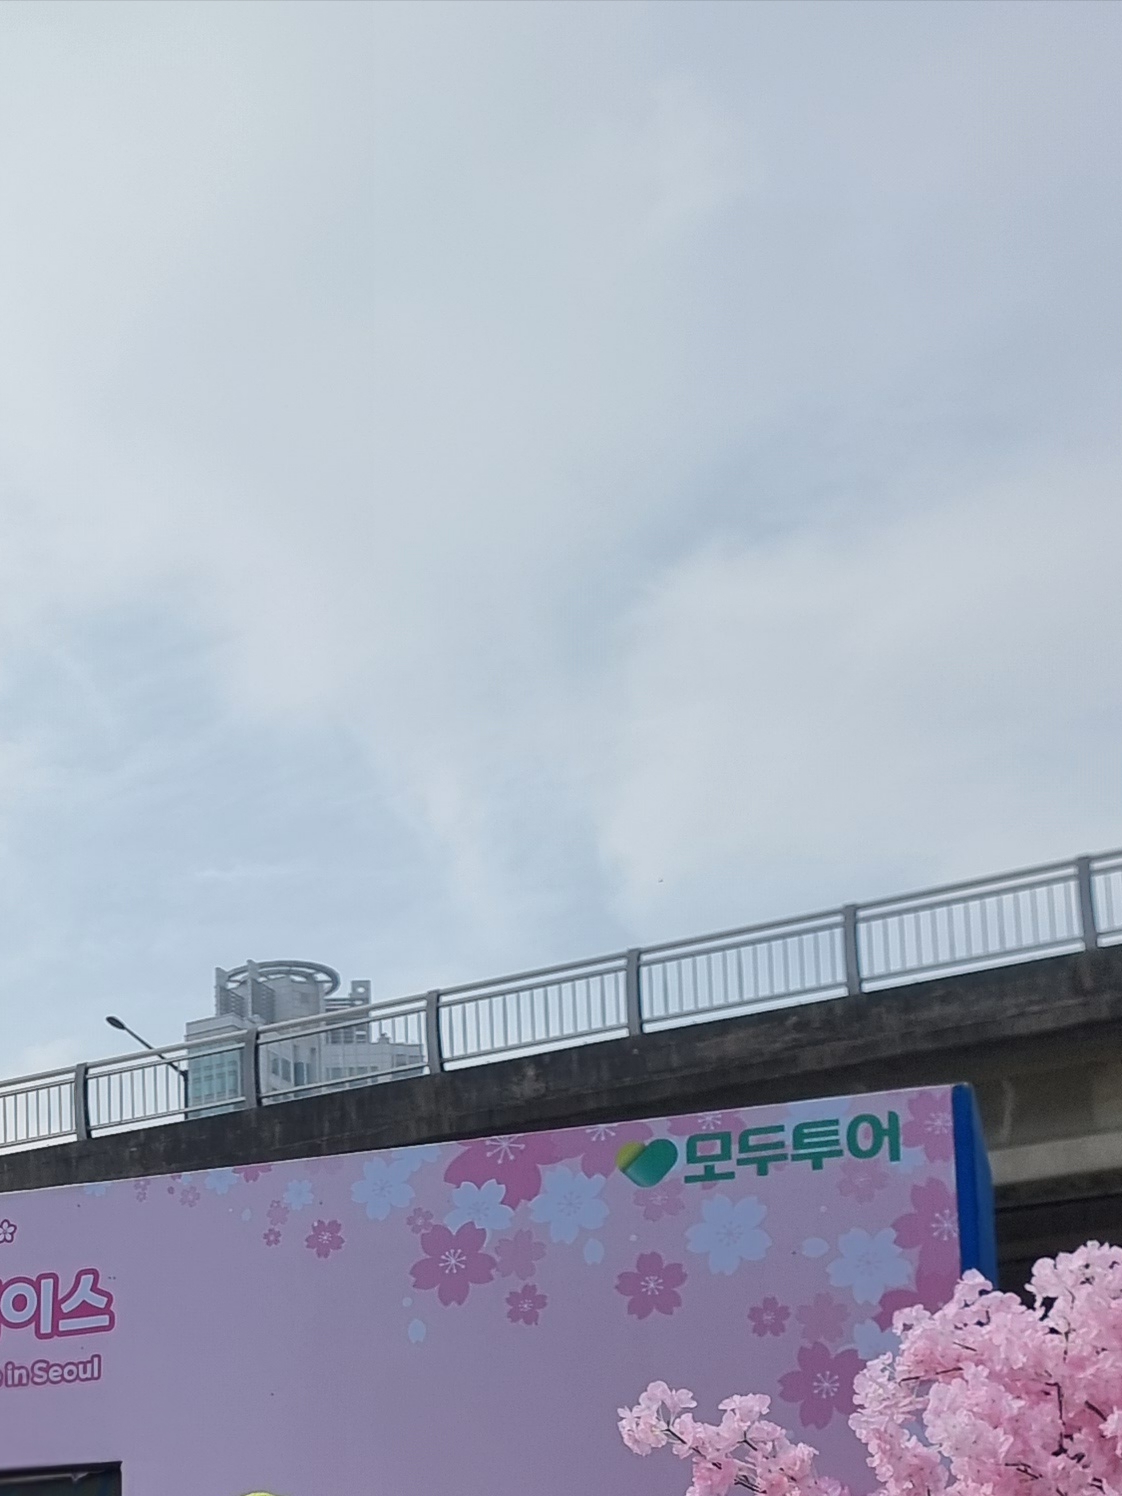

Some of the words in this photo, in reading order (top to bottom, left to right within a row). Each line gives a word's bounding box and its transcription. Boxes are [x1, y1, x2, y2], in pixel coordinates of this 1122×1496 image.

[684, 1110, 901, 1183] 모두투어
[5, 1361, 29, 1386] in
[31, 1355, 101, 1384] Seoul
